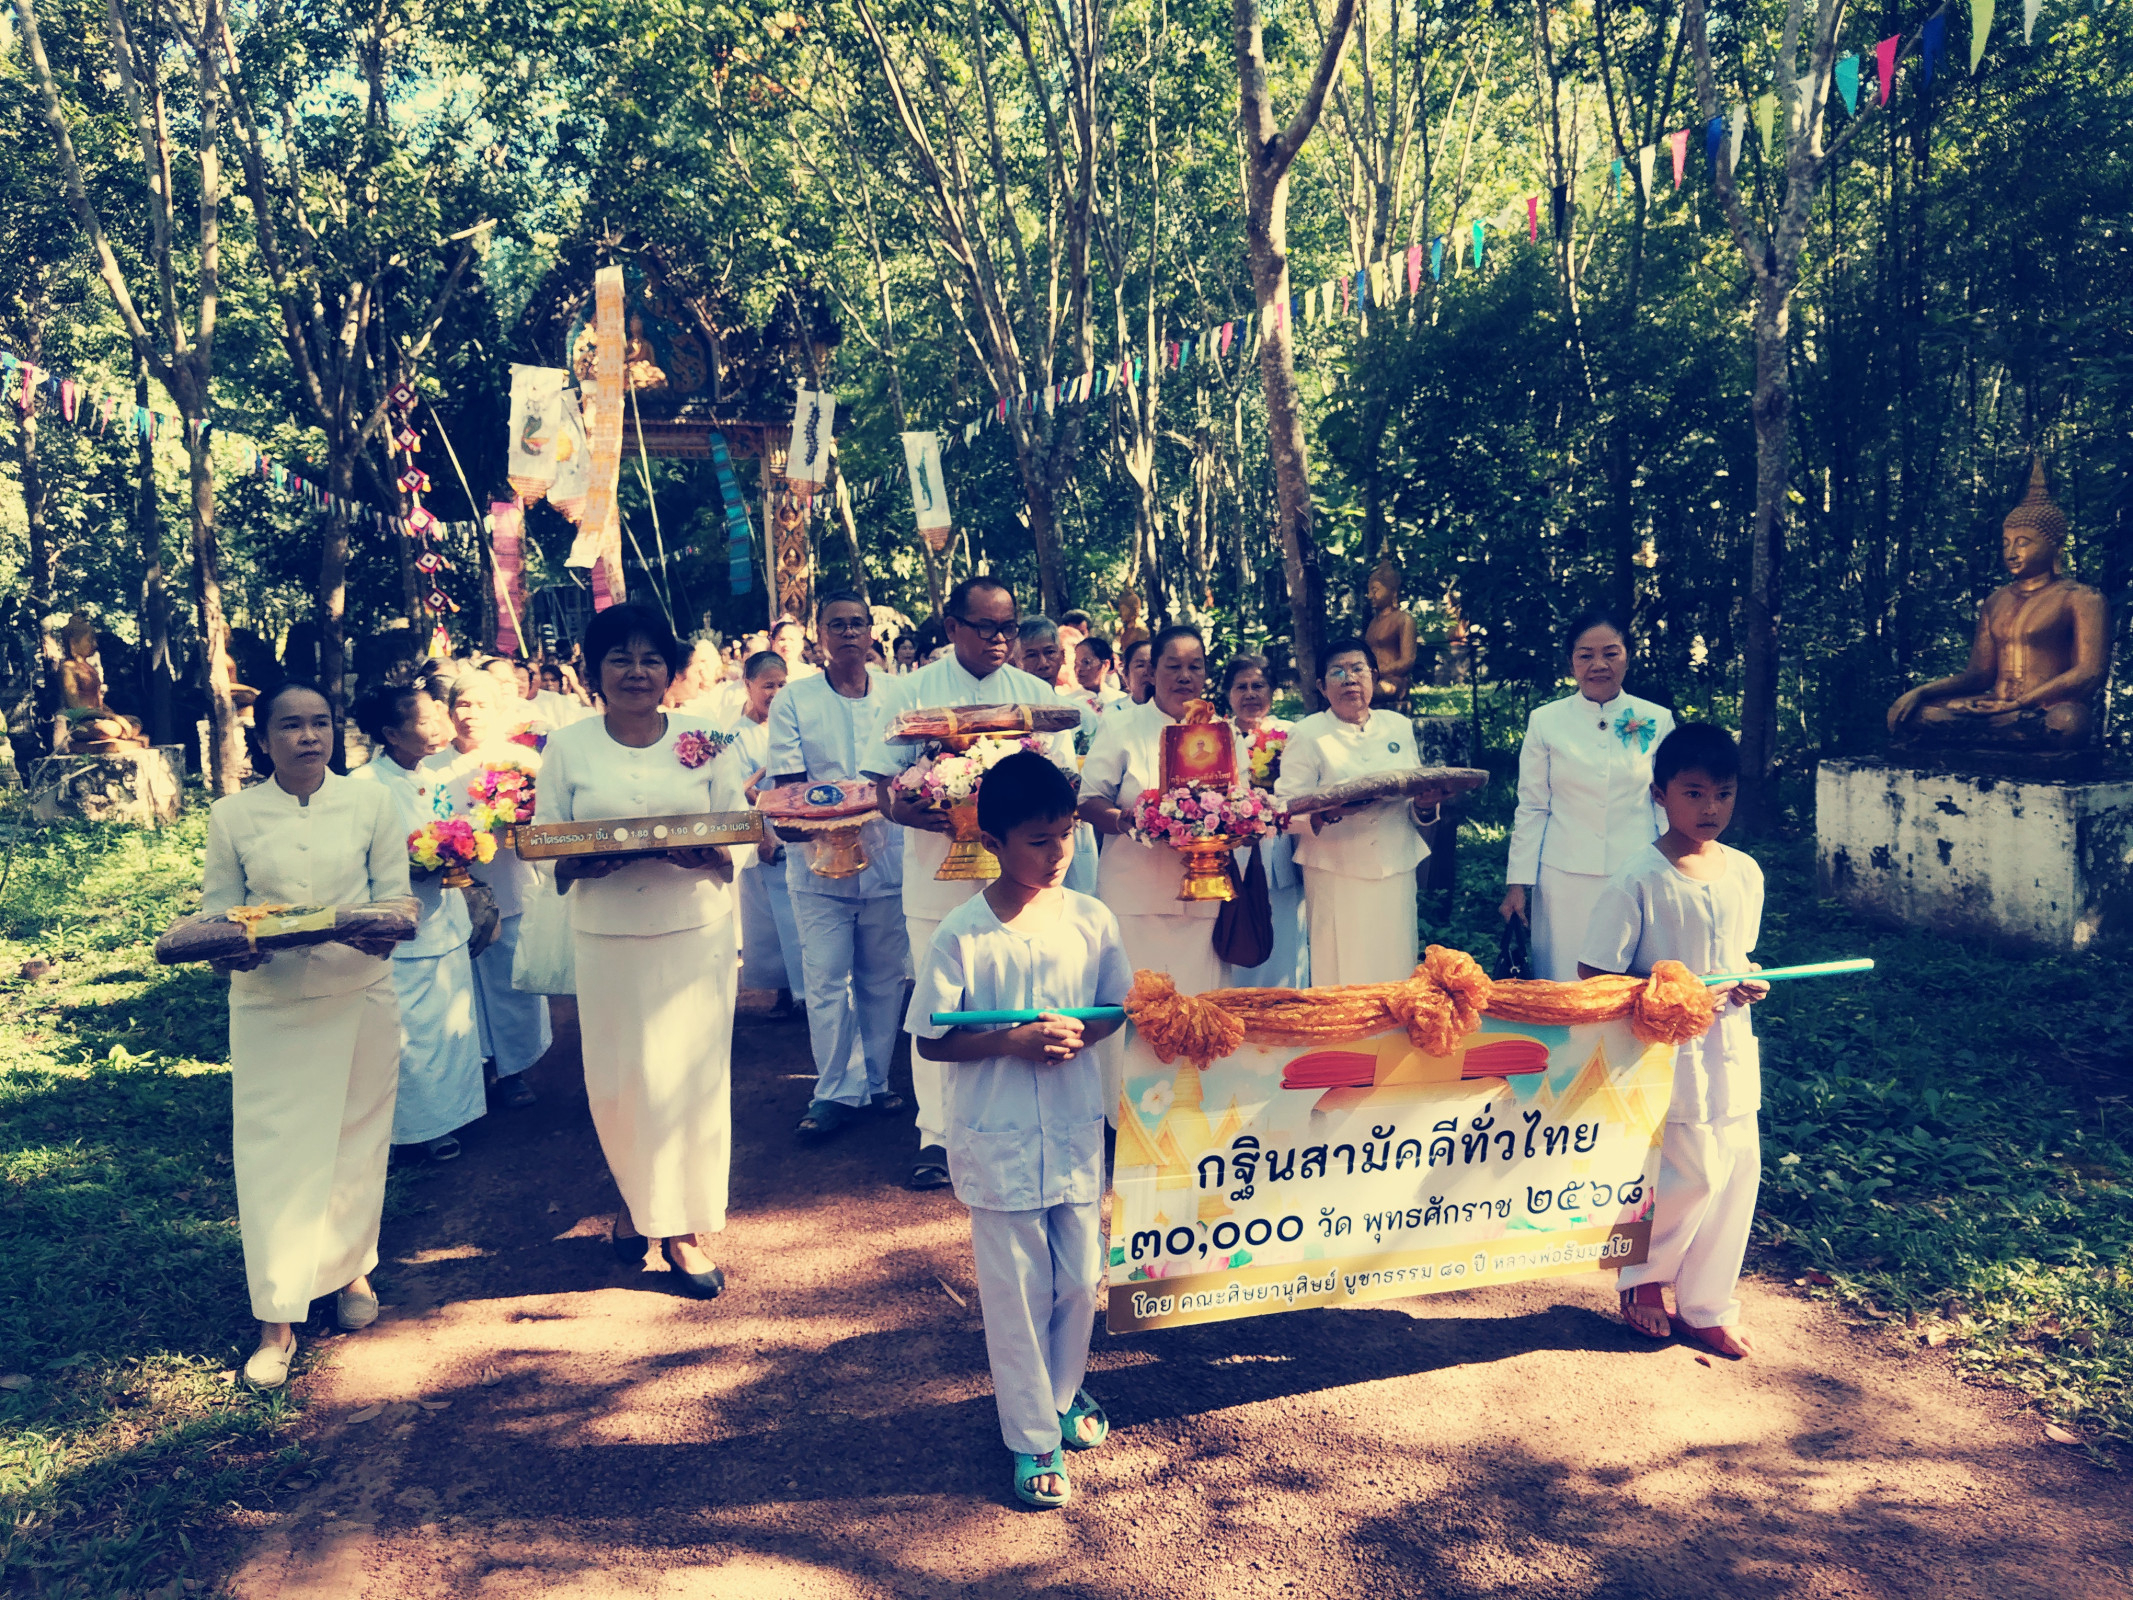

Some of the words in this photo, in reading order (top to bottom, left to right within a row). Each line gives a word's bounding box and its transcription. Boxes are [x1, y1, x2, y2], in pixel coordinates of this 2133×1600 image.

[670, 826, 688, 835] 1.90
[730, 822, 751, 831] เมตร
[1197, 1102, 1600, 1201] กฐินสามัคคีทั่วไทย
[1131, 1215, 1304, 1260] ๓๐,๐๐๐
[1318, 1206, 1352, 1238] วัด
[1363, 1195, 1512, 1243] พุทธศักราช
[1526, 1174, 1645, 1214] ๒๕๖๘
[1132, 1293, 1172, 1316] โดย
[1181, 1269, 1336, 1309] คณะศิษยานุศิษย์
[1344, 1265, 1432, 1295] บูชาธรรม
[1440, 1262, 1466, 1276] ๘๑
[1474, 1253, 1486, 1272] ปี
[1494, 1236, 1631, 1270] หลวงพ่อธัมมชโย
